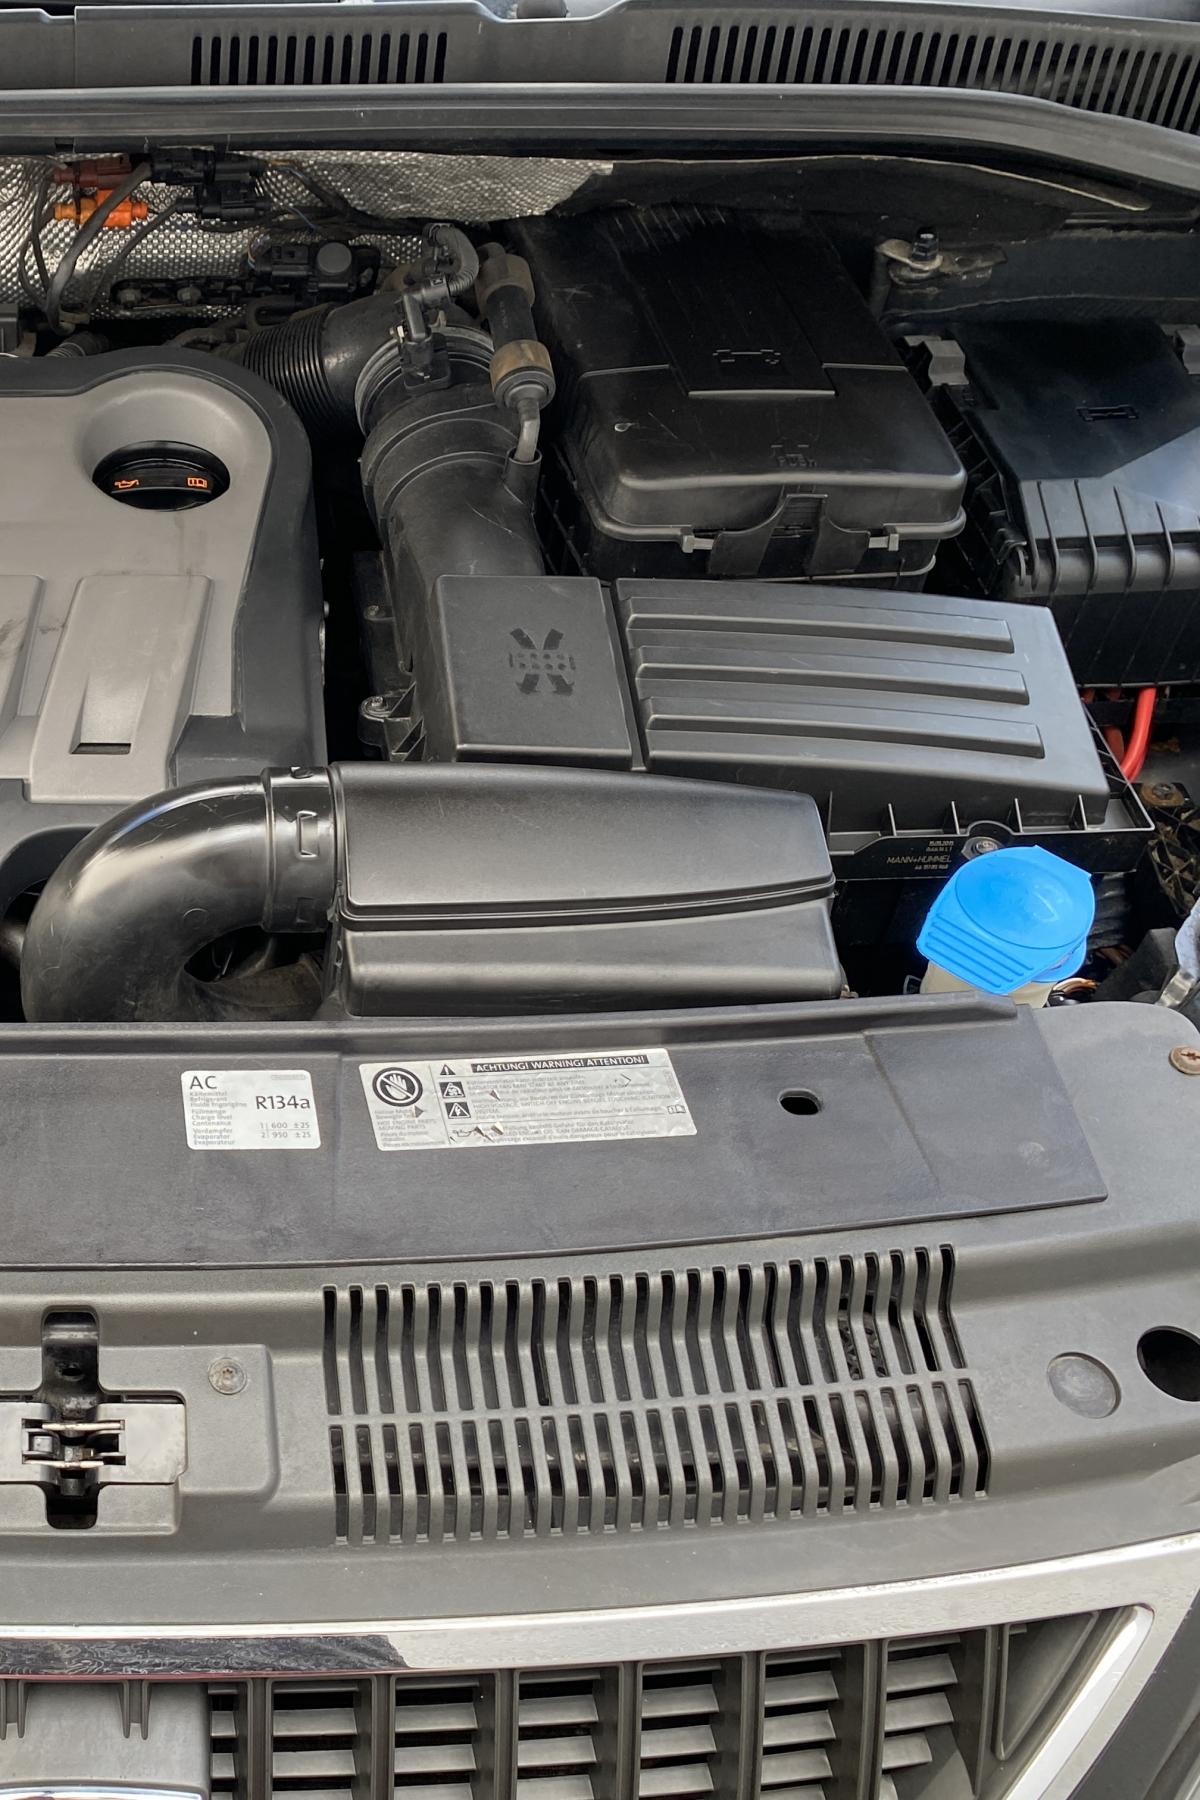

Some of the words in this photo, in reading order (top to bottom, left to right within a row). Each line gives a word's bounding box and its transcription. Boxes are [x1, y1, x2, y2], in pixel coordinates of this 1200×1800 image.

[476, 1061, 528, 1072] ACHTUNG!
[532, 1059, 584, 1069] WARNING!
[586, 1056, 645, 1066] ATTENTION!
[190, 1076, 218, 1090] AC
[256, 1095, 310, 1110] R134a
